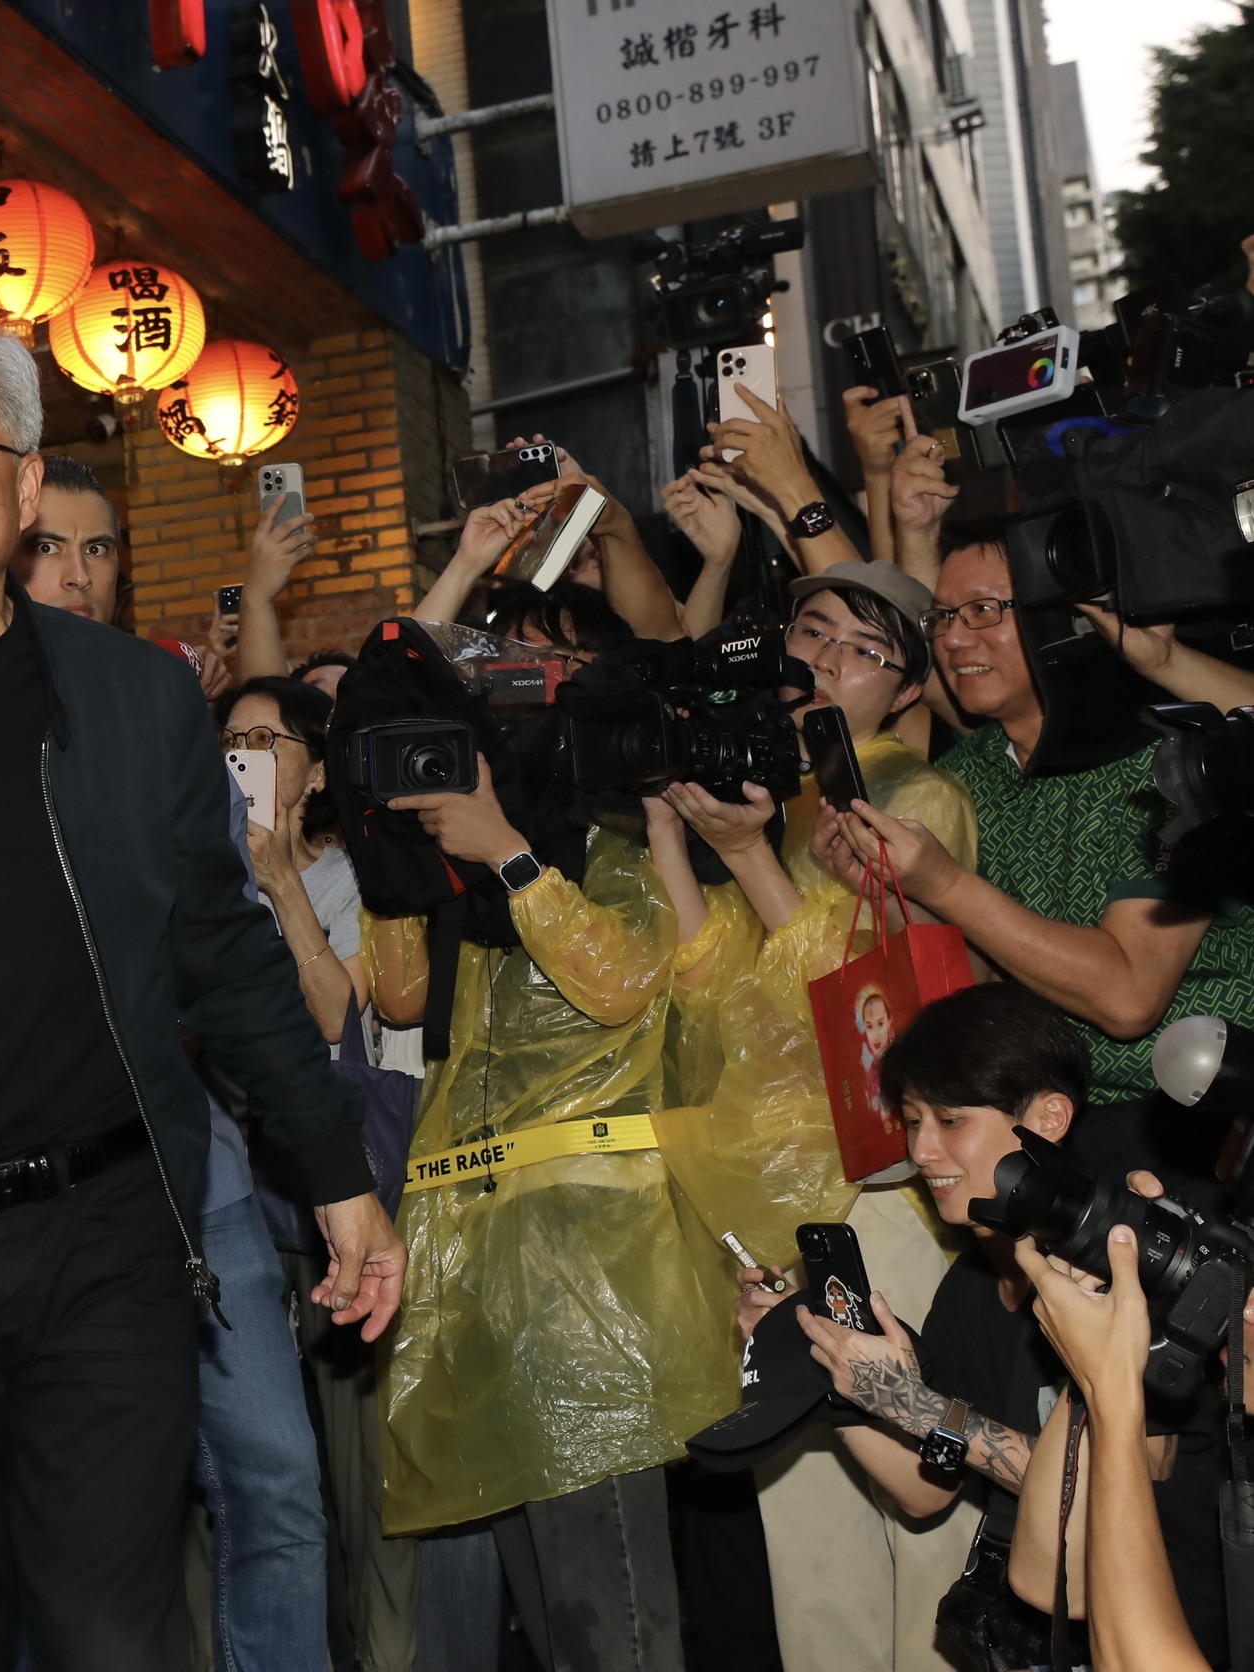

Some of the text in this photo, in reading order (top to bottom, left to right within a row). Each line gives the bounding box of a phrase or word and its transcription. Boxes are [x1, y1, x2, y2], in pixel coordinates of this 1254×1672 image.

[620, 2, 785, 70] 誠楷牙科
[597, 55, 821, 124] 0800-899-997
[629, 111, 795, 168] 請上7號 3F
[108, 266, 173, 353] 喝酒
[1174, 347, 1183, 368] SWIT
[721, 636, 761, 654] NTDTV
[728, 652, 758, 664] XDCAM
[511, 679, 544, 687] XDCAM
[416, 1157, 451, 1180] THE
